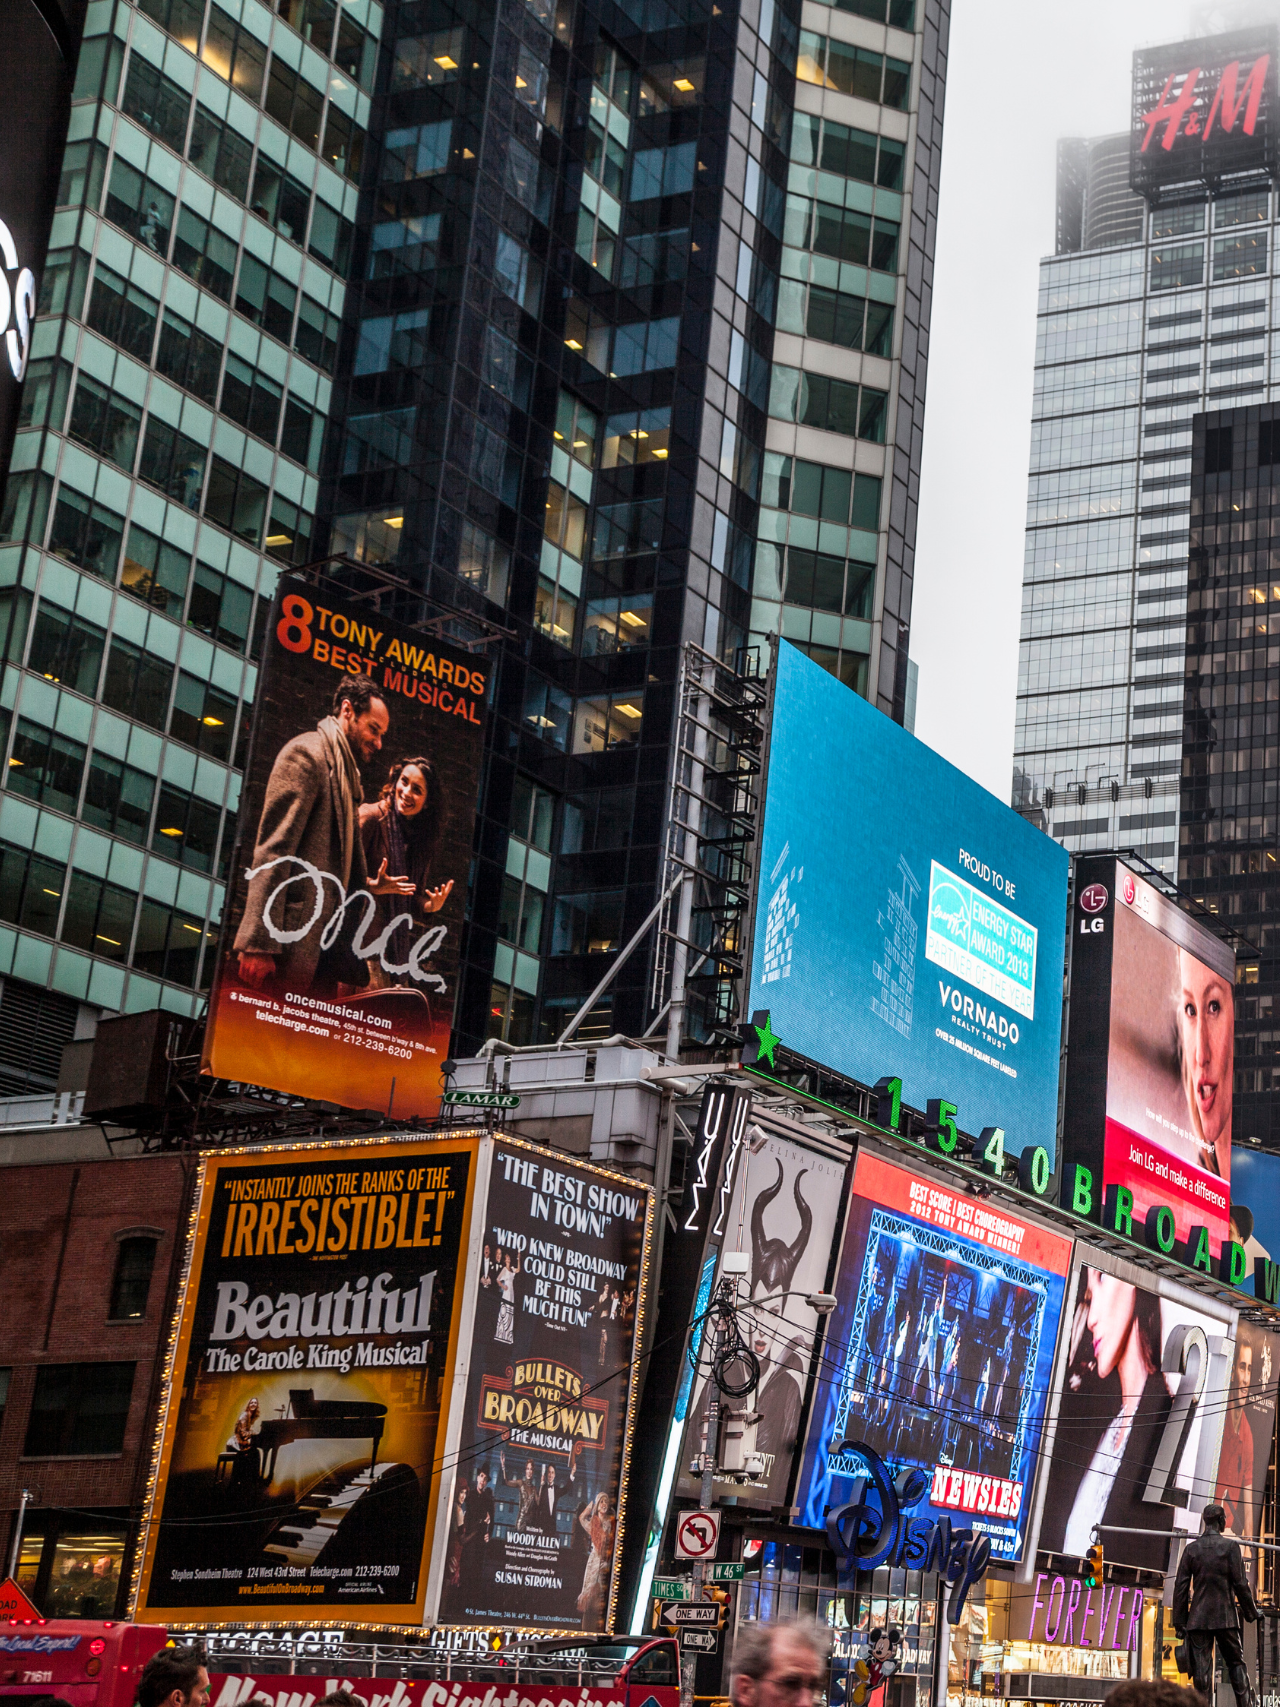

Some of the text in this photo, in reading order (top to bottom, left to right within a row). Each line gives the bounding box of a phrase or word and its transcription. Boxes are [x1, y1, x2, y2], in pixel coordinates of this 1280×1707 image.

[1141, 54, 1270, 152] H&M
[276, 594, 314, 653] 8
[315, 606, 486, 695] TONY AWARDS
[359, 648, 448, 689] INCLUDING
[312, 638, 482, 725] BEST MUSICAL
[958, 848, 1016, 900] PROUD TO BE
[972, 900, 1033, 956] ENERGY STAR
[1080, 918, 1104, 934] LG
[970, 929, 1029, 981] AWARD 2013
[928, 936, 1032, 1015] PARTNER OF THE YEAR
[238, 992, 272, 1009] bernard
[281, 1004, 310, 1020] jacobs
[310, 1011, 341, 1029] theatre,
[285, 992, 392, 1029] oncemusical.com
[939, 980, 1020, 1045] VORNADO
[255, 1009, 413, 1061] telecharge.com or 212-239-6200
[935, 1027, 949, 1043] OVER
[951, 1014, 1007, 1051] REALTY TRUST
[449, 1093, 514, 1106] LAMAR
[878, 1076, 1049, 1194] 1540
[295, 1173, 334, 1197] JOINS
[335, 1172, 360, 1195] THE
[361, 1169, 404, 1194] RANKS
[407, 1168, 426, 1191] OF
[426, 1166, 451, 1190] THE
[811, 1161, 844, 1181] JOLIE
[1128, 1143, 1226, 1209] Join LG and make a difference
[530, 1191, 550, 1221] IN
[541, 1167, 586, 1205] BEST
[587, 1185, 639, 1222] SHOW
[909, 1181, 1025, 1244] BEST SCORE BEST CHOREOGRAPHY
[909, 1200, 1021, 1255] 2012 TONY AWARD WINNER!
[524, 1256, 598, 1293] COULD STILL
[529, 1237, 564, 1263] KNEW
[565, 1249, 628, 1281] BROADWAY
[209, 1269, 438, 1341] Beautiful
[522, 1295, 559, 1320] MUCH
[535, 1279, 582, 1307] BE THIS
[206, 1339, 430, 1374] The Carole King Musical
[514, 1362, 581, 1399] BULLETS
[534, 1385, 562, 1403] OVER
[484, 1391, 604, 1440] BROADWAY
[1142, 1324, 1236, 1512] 21
[511, 1428, 530, 1444] THE
[930, 1466, 1023, 1518] NEWSIES
[506, 1531, 560, 1549] WOODY ALLEN
[170, 1565, 399, 1582] Stephen Sondheim Theatre 124 West 43rd Street Telecharge.com 212-239-6200
[495, 1570, 563, 1589] SUSAN STROMAN
[654, 1581, 675, 1597] TIMES
[715, 1564, 743, 1579] W 46 ST
[676, 1609, 713, 1619] ONE WAY
[1028, 1573, 1143, 1651] FOREVER
[686, 1634, 713, 1645] ONE WAY
[23, 1671, 52, 1683] 71611
